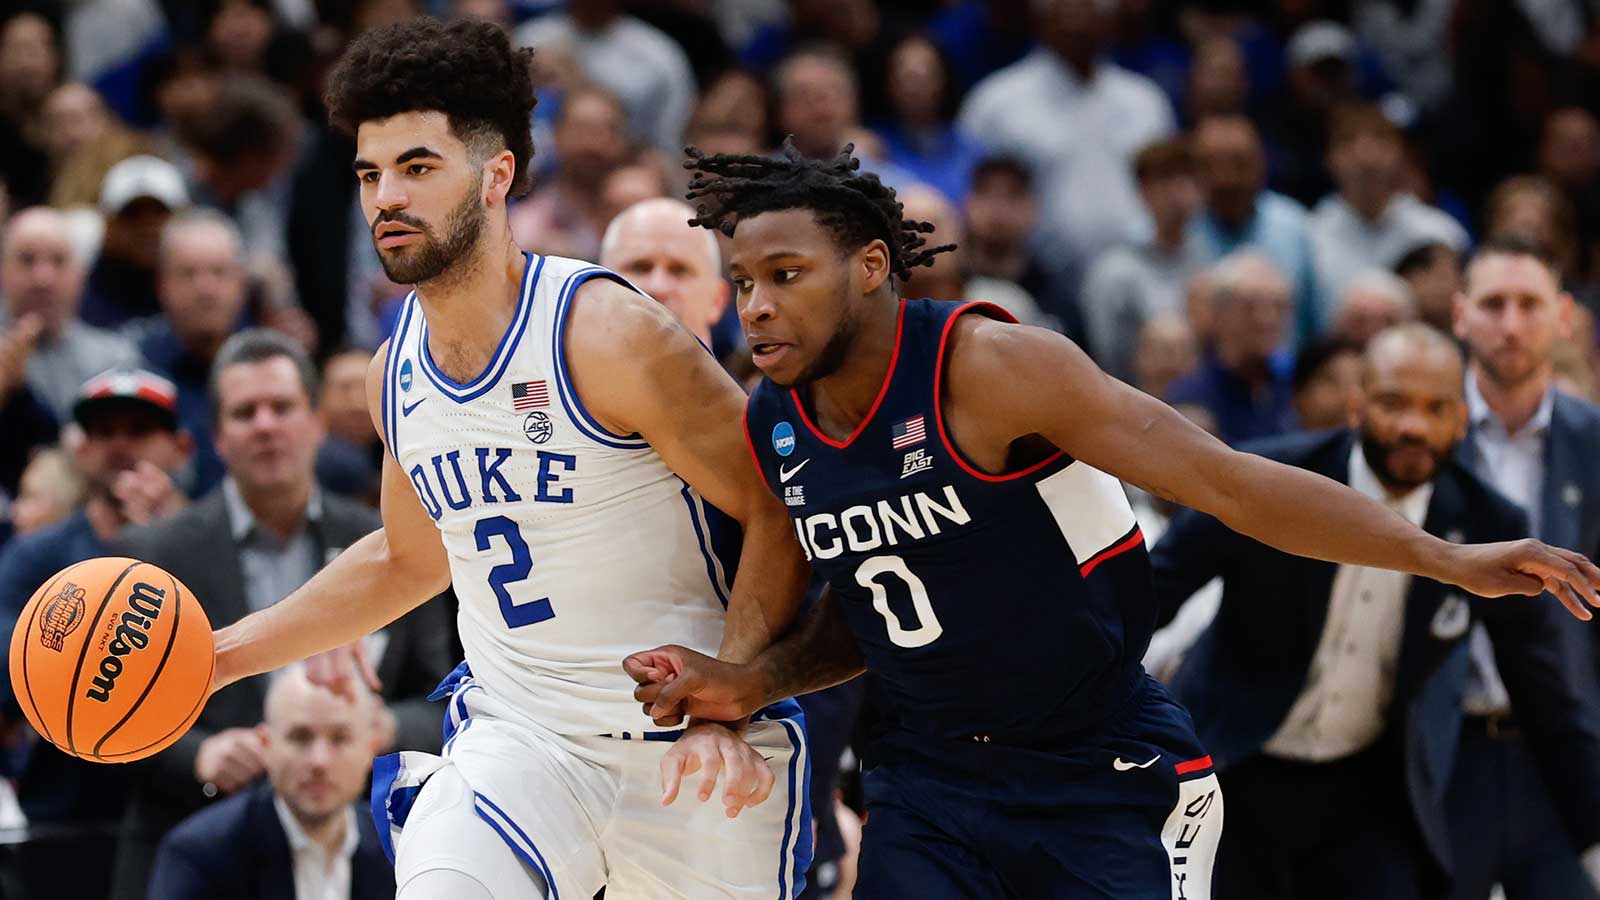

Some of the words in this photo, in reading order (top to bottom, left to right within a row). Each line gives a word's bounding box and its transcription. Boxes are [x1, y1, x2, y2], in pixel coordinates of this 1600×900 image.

[528, 420, 550, 431] ACC
[902, 455, 934, 474] EAST
[904, 448, 925, 465] BIG
[410, 447, 576, 521] DUKE
[474, 515, 556, 629] 2
[56, 595, 80, 634] MARCH
[855, 555, 943, 648] 0
[42, 598, 68, 649] MADNESS
[107, 612, 119, 631] EVO
[86, 581, 166, 703] Wilson
[99, 632, 109, 652] NXT
